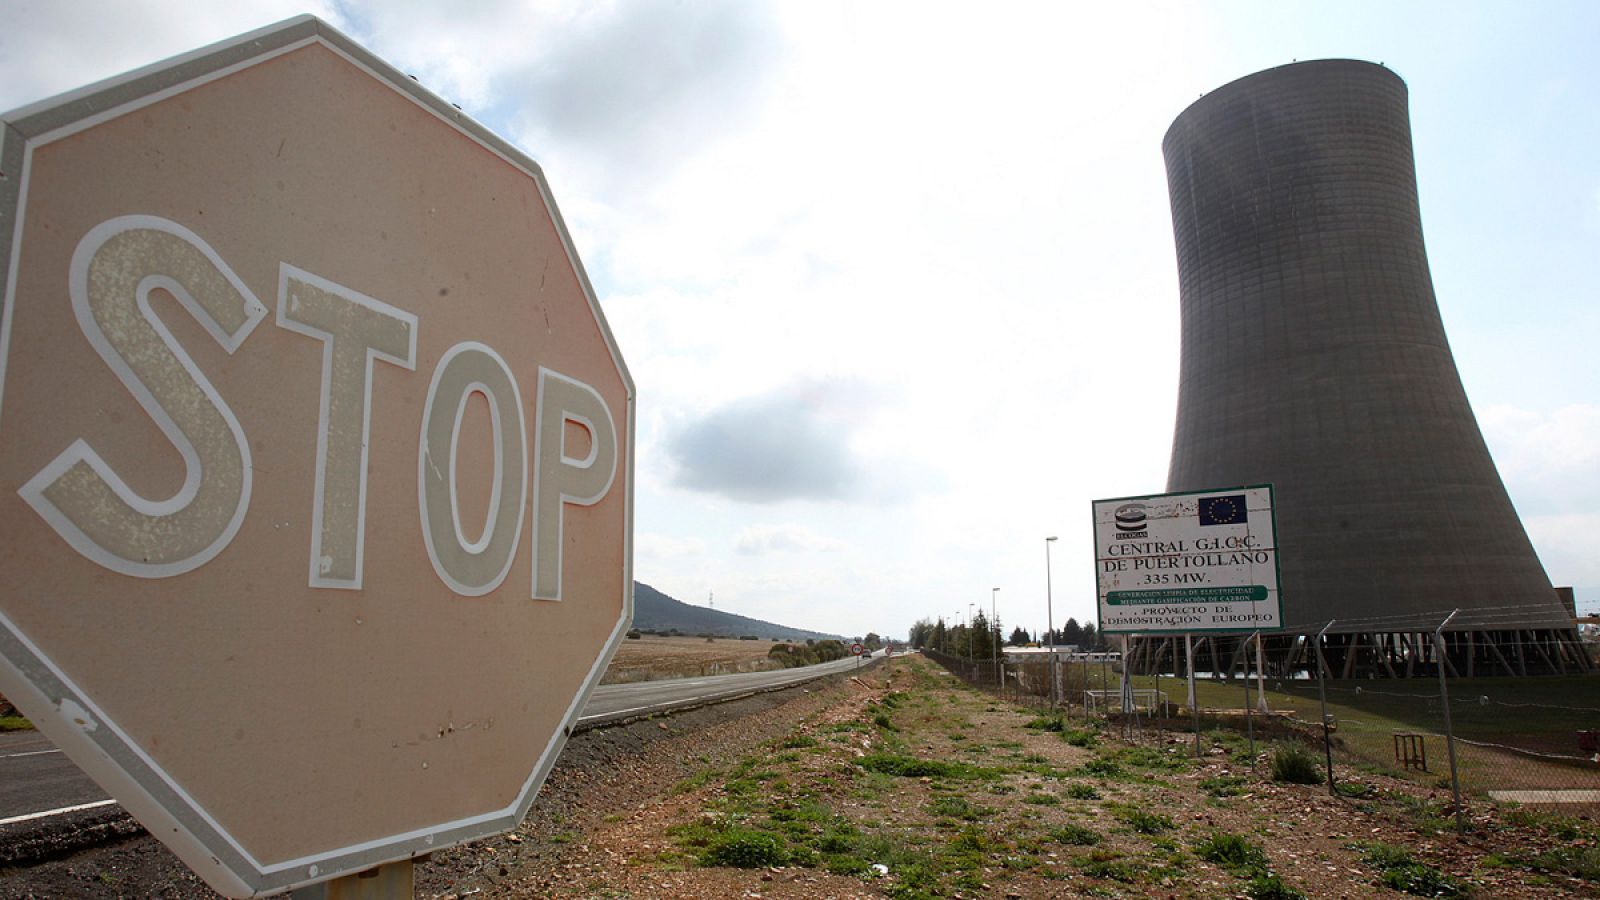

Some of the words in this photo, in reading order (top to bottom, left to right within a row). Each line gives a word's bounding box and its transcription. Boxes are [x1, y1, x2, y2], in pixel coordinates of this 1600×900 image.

[18, 214, 618, 601] STOP
[1108, 540, 1189, 556] CENTRAL
[1104, 560, 1128, 573] DE
[1134, 551, 1269, 571] PUERTOLLANO
[1144, 574, 1169, 585] 335
[1143, 606, 1208, 616] PROYECTO
[1212, 614, 1273, 623] EUROPEO
